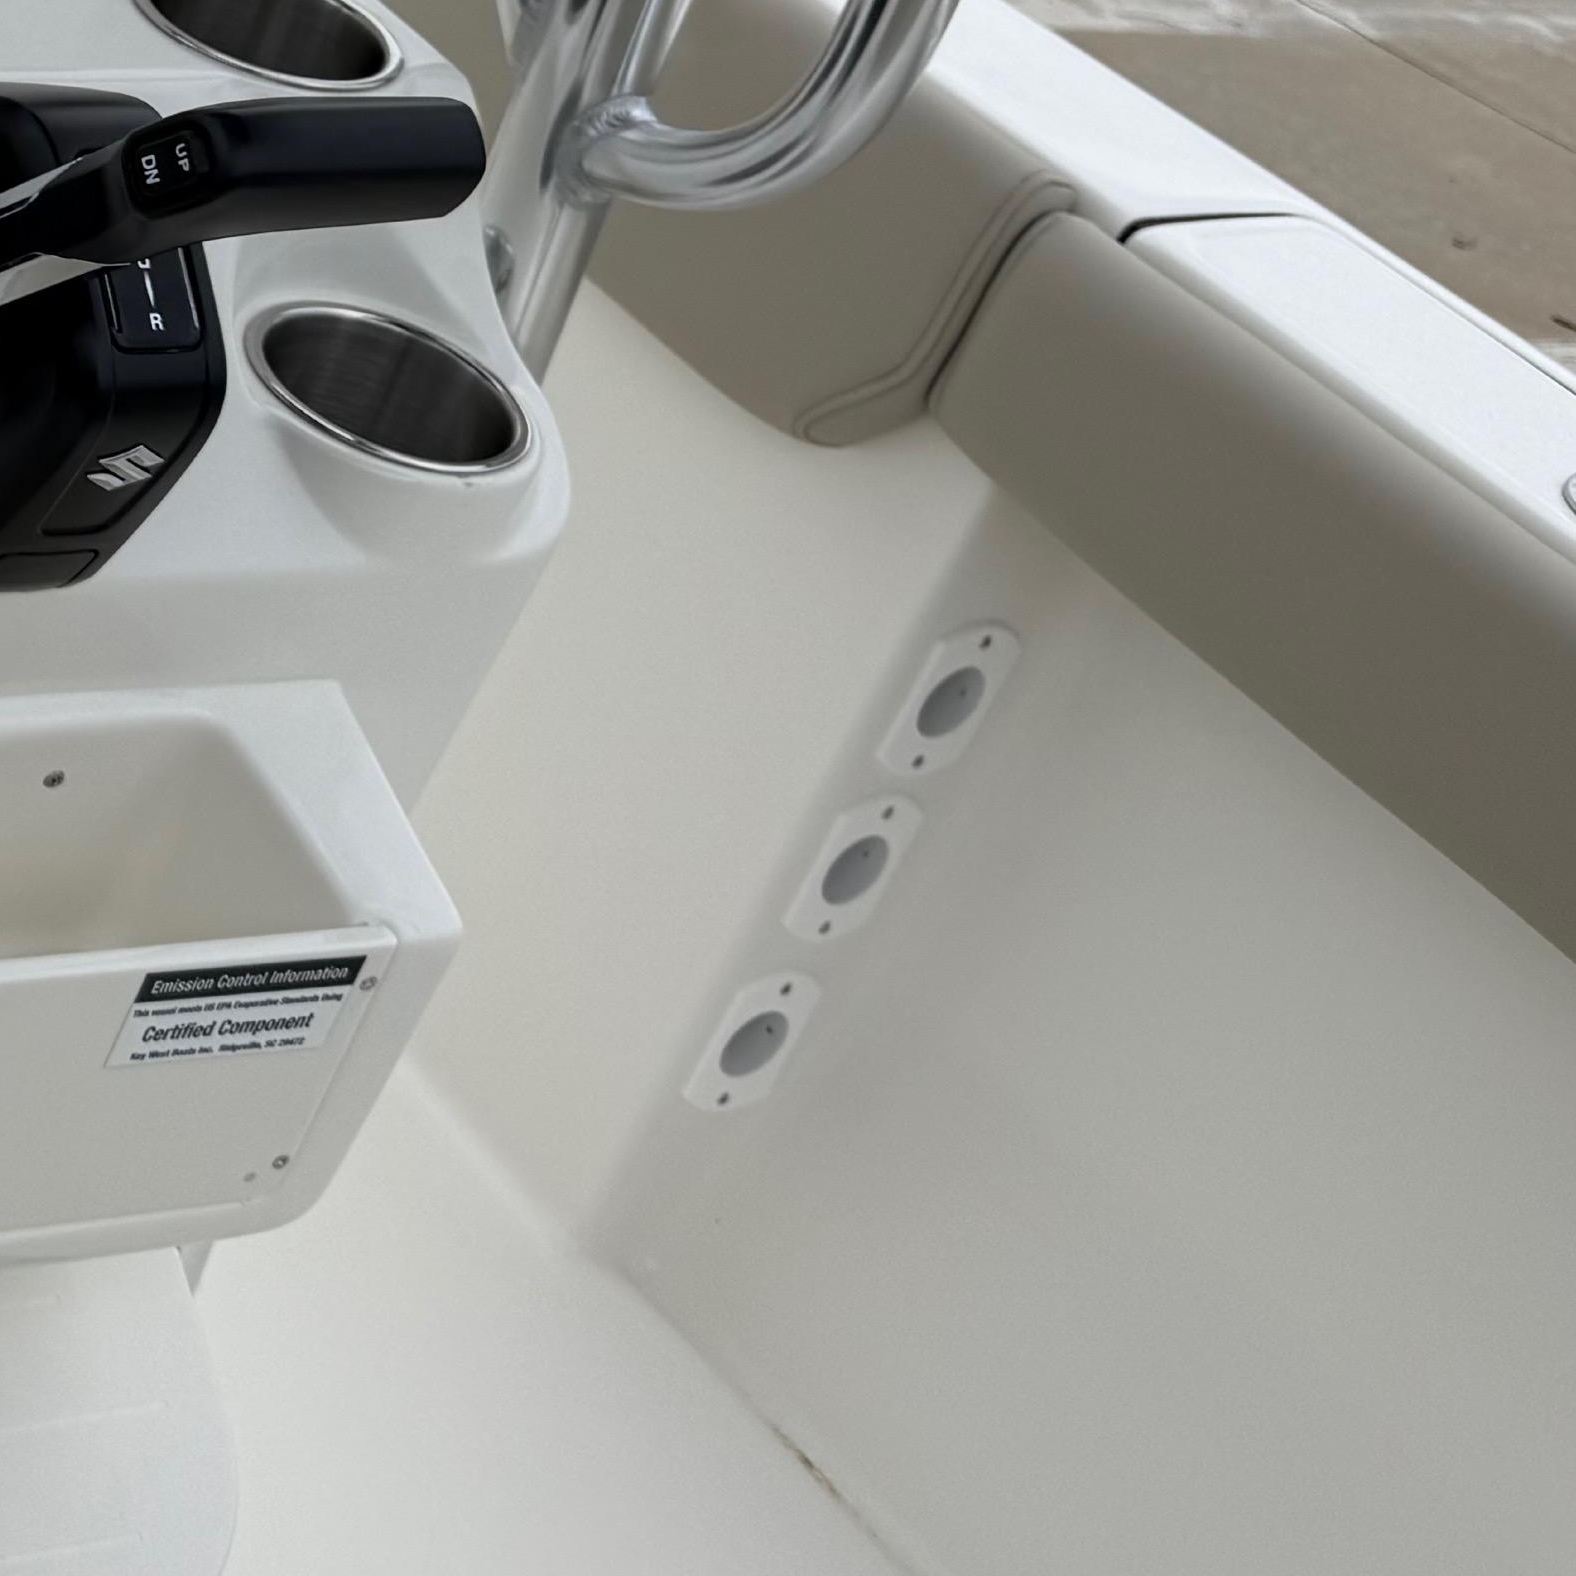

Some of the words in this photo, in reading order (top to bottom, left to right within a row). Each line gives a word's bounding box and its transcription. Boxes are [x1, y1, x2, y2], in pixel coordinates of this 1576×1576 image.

[141, 154, 161, 184] DN
[175, 143, 189, 171] UP
[149, 312, 165, 331] R
[151, 977, 215, 994] Emission
[216, 972, 268, 988] Control
[270, 965, 350, 983] Information
[141, 1021, 217, 1043] Certified
[218, 1012, 314, 1036] Component
